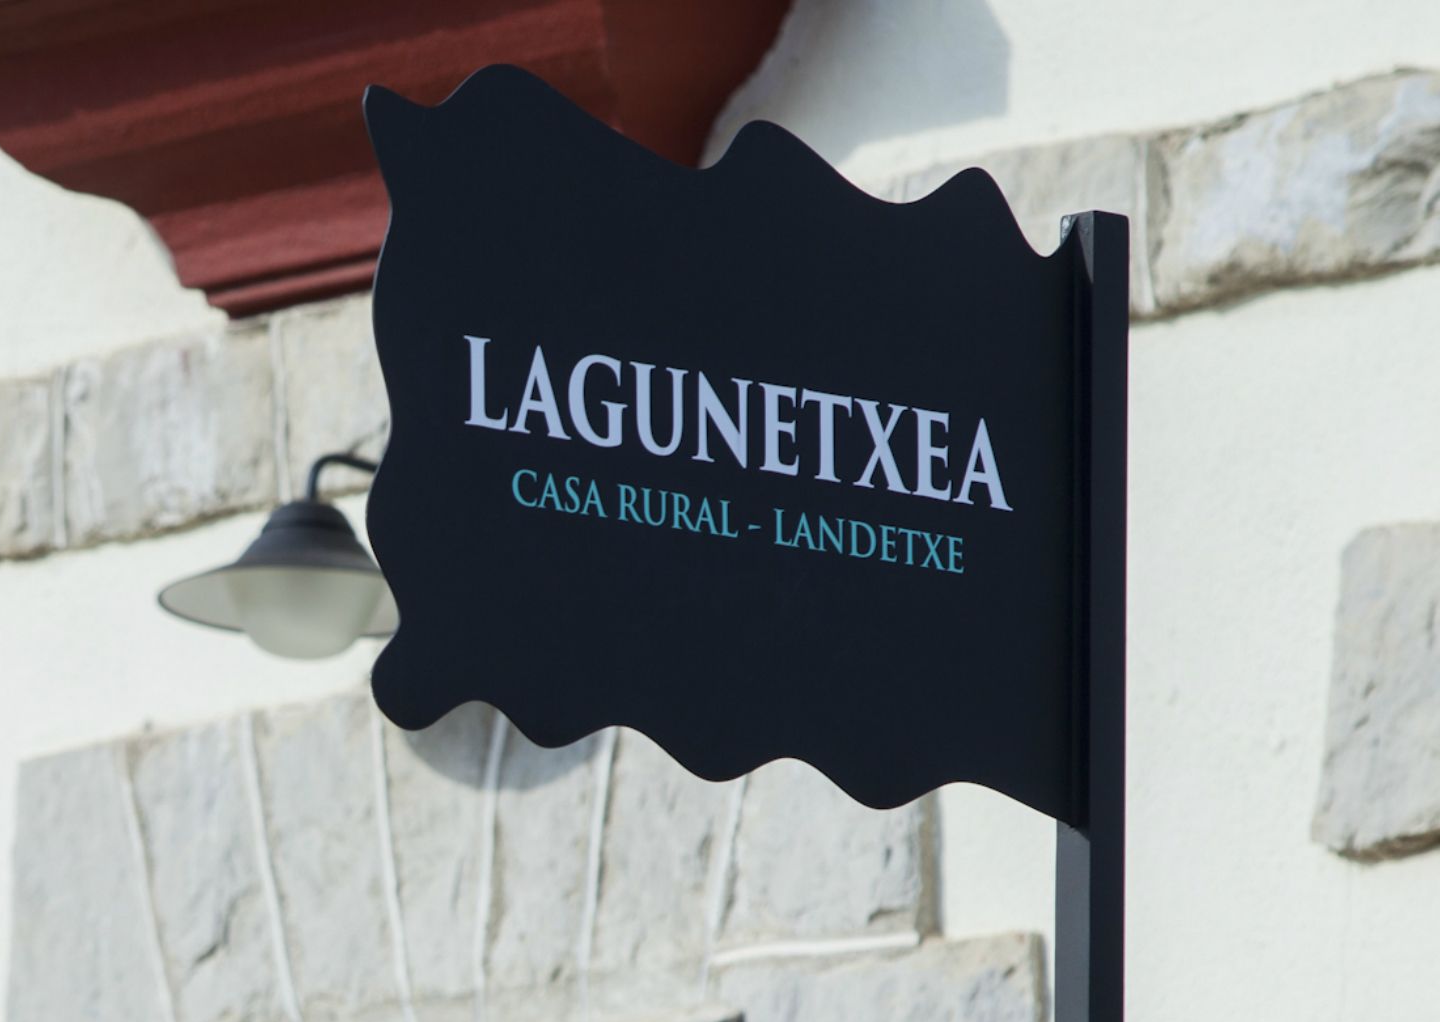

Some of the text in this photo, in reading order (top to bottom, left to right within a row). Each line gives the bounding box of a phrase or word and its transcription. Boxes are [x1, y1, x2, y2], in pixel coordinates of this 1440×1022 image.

[463, 335, 1014, 511] LAGUNETXEA
[511, 469, 608, 518] CASA
[616, 483, 740, 538] RURAL
[772, 508, 965, 574] LANDETXE
